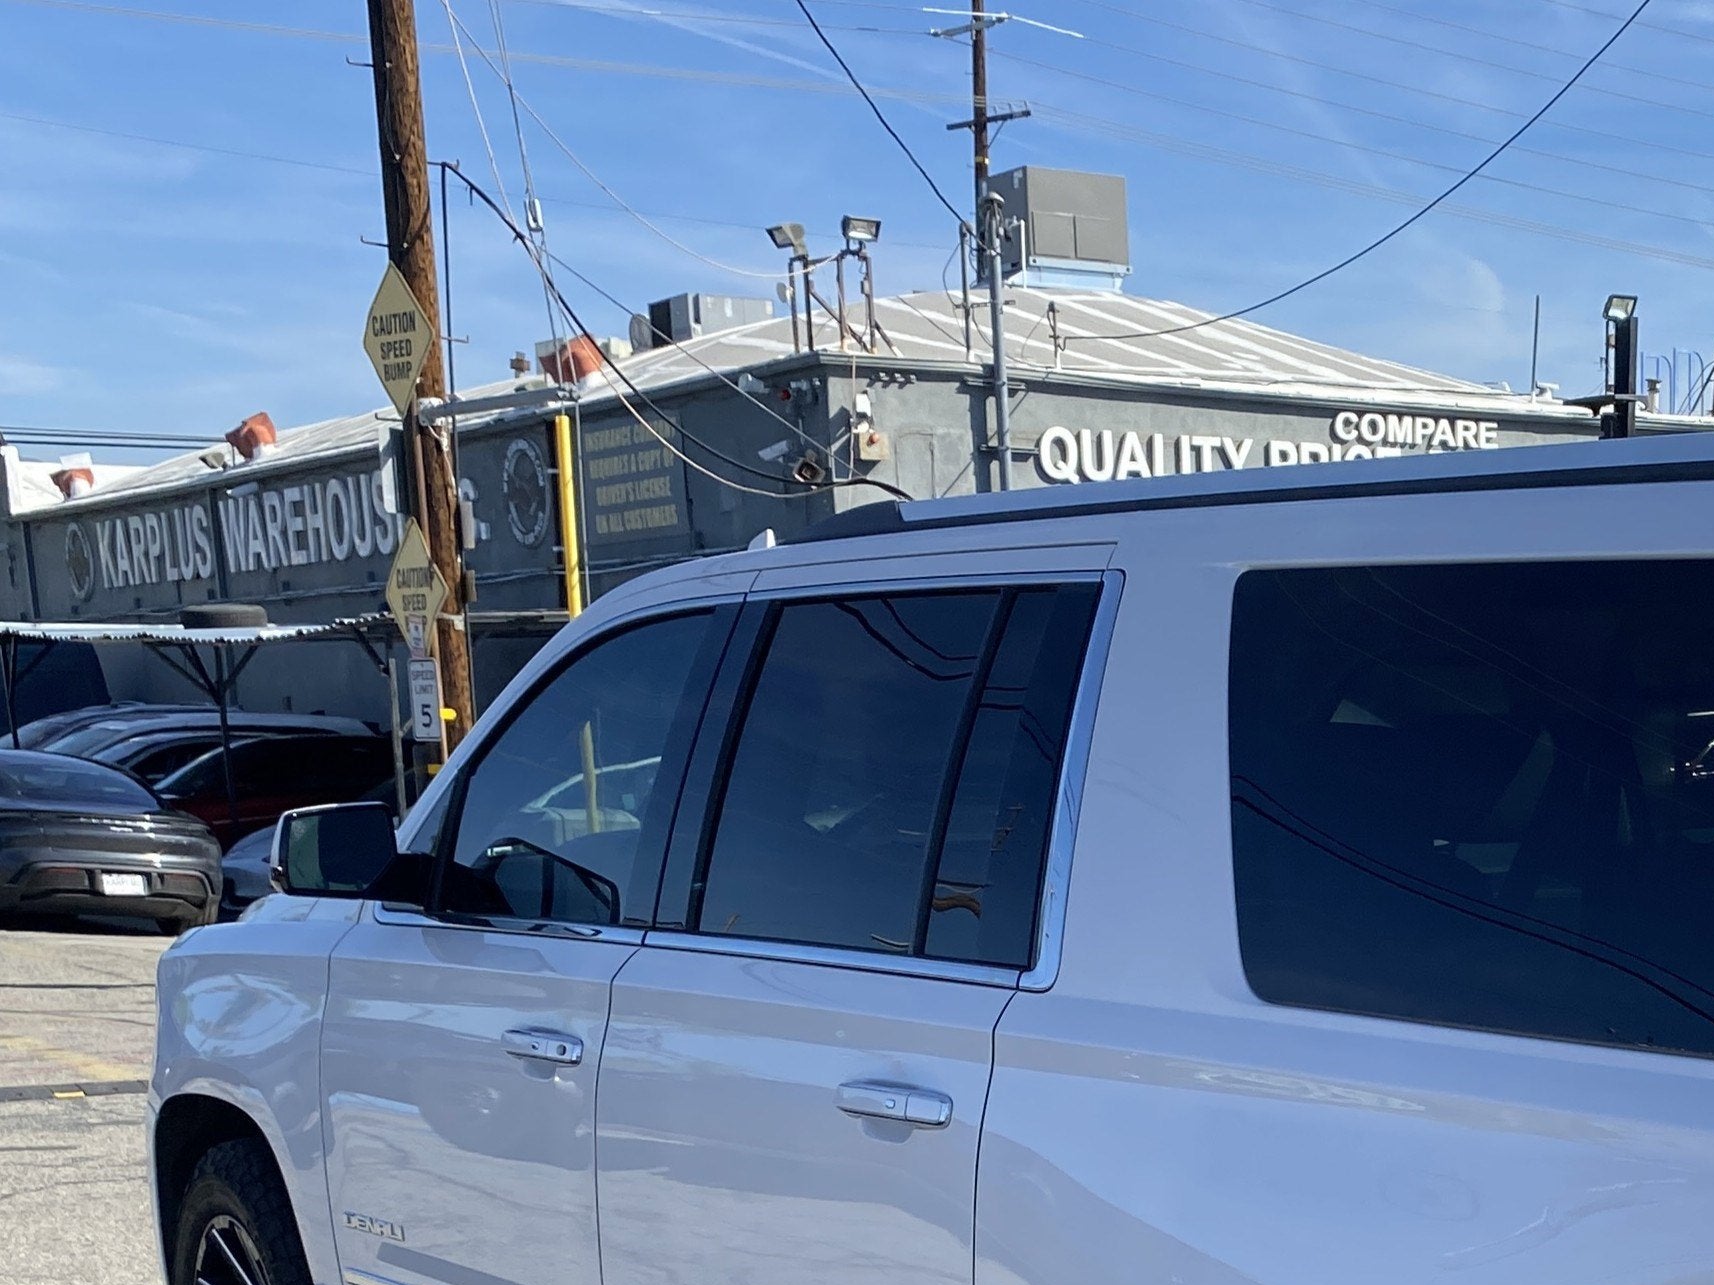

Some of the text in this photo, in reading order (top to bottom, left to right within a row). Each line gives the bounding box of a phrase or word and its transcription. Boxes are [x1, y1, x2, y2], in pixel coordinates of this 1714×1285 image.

[371, 311, 416, 337] CAUTION
[380, 338, 412, 360] SPEED
[383, 361, 413, 381] BUMP
[1333, 411, 1498, 449] COMPARE
[96, 505, 213, 588] KARPLUS
[218, 470, 403, 573] WAREHOUS
[396, 566, 433, 590] CAUTION
[402, 593, 427, 611] SPEED
[411, 670, 436, 681] SPEED
[414, 684, 434, 694] LIMIT
[421, 703, 432, 728] 5
